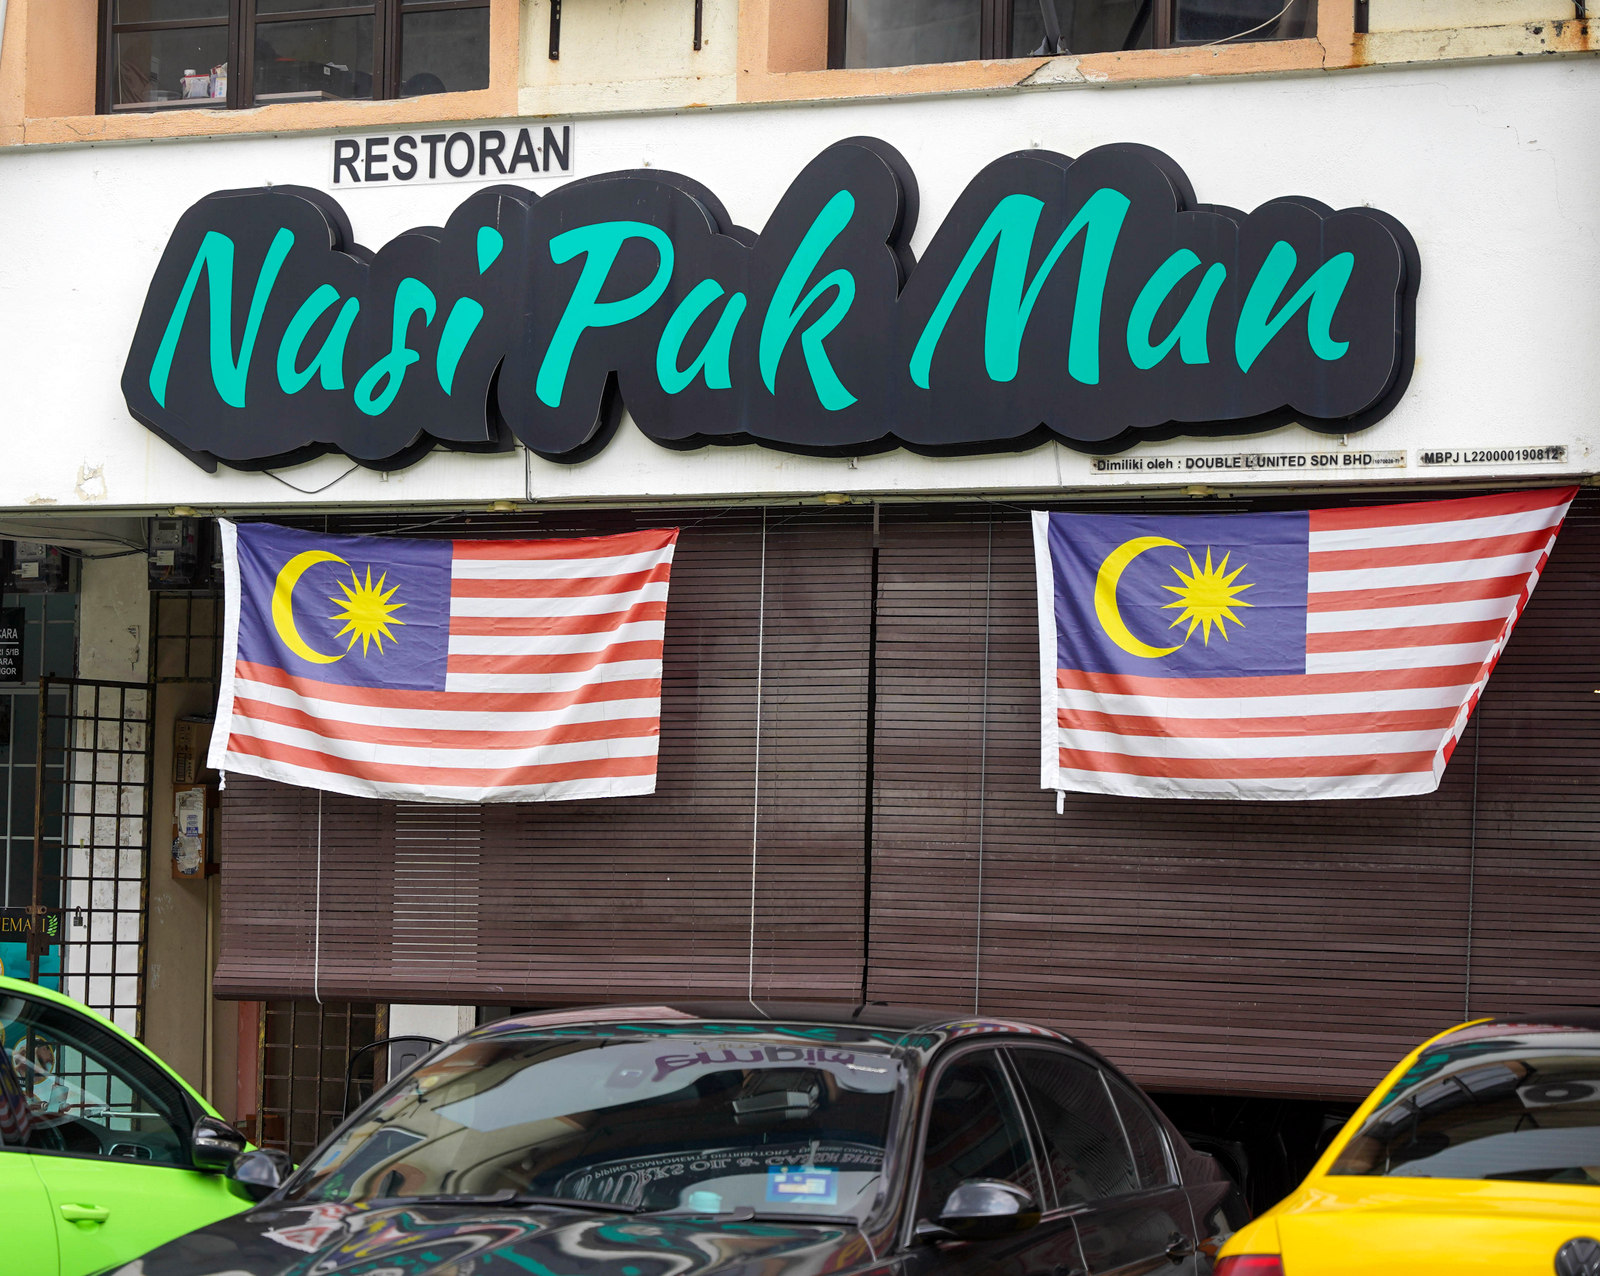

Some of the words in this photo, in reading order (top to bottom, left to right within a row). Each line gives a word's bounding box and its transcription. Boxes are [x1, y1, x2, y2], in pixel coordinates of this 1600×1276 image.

[333, 125, 570, 184] RESTORAN
[148, 225, 504, 417] Nasi
[535, 189, 859, 411] Pak
[908, 187, 1355, 390] Man
[1097, 457, 1143, 471] Dimiliki
[1146, 458, 1173, 470] oleh
[1185, 456, 1242, 470] DOUBLE
[1310, 454, 1339, 467] SDN
[1343, 454, 1372, 466] BHD
[1424, 451, 1460, 464] MBPJ
[1463, 448, 1559, 463] L220000190812
[0, 628, 18, 639] ARA
[0, 667, 17, 675] GOR
[0, 917, 46, 933] EMAI
